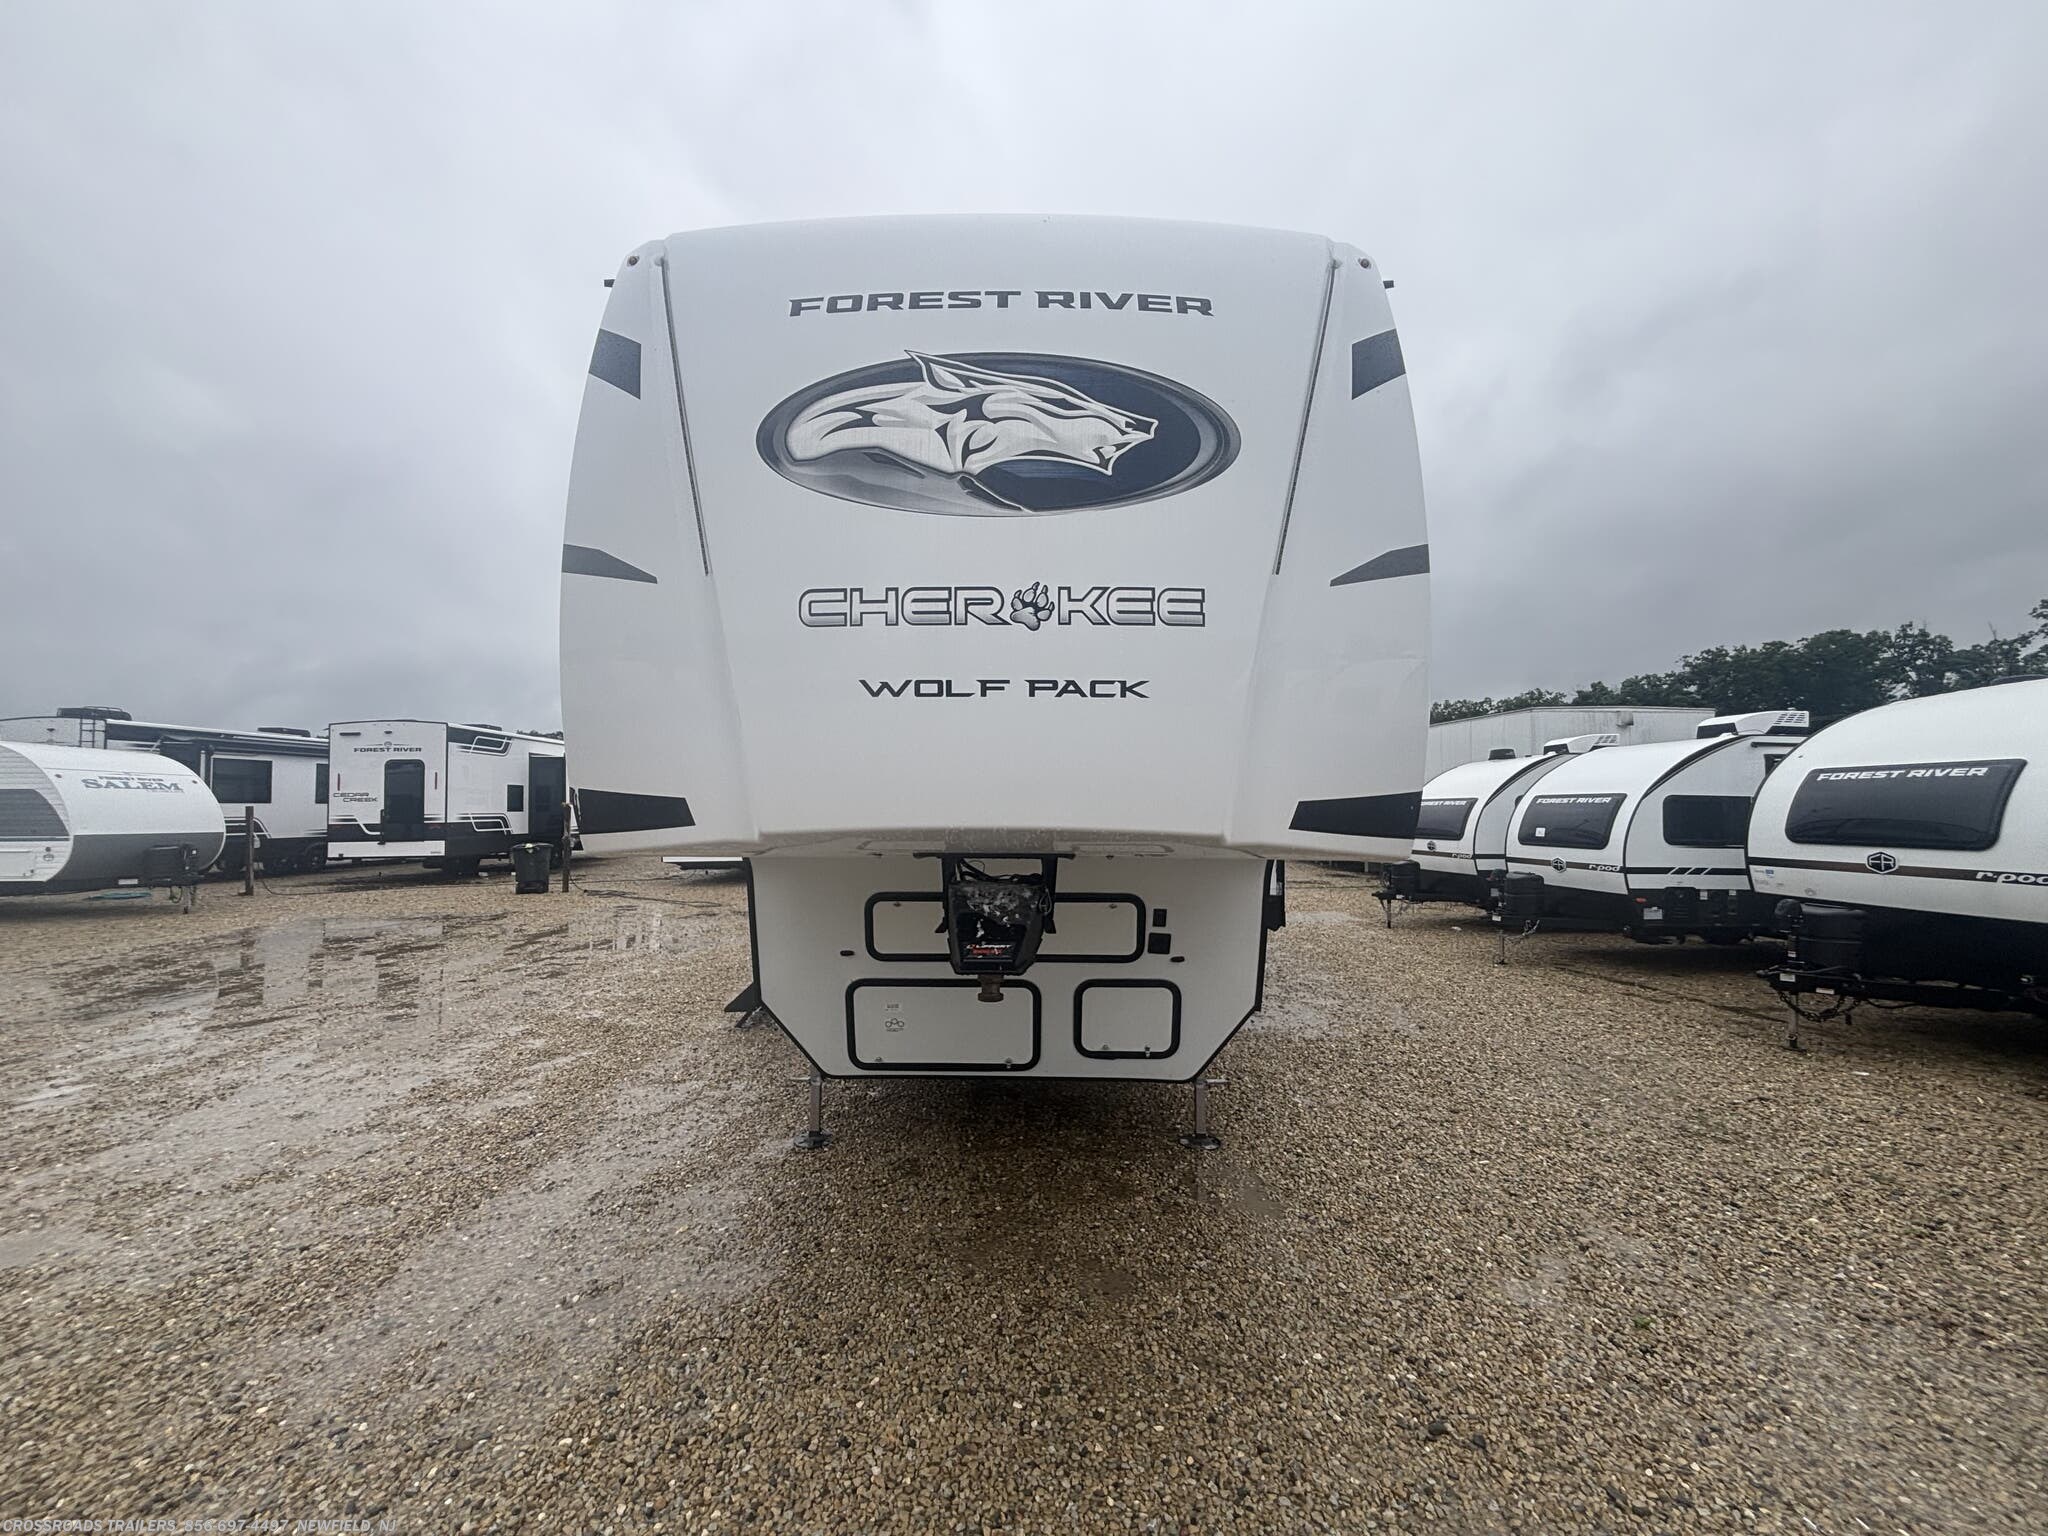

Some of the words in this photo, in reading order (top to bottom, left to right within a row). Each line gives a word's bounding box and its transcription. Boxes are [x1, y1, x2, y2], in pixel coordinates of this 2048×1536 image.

[788, 290, 1022, 317] FOREST
[1032, 290, 1215, 317] RIVER
[858, 679, 1011, 699] WOLF
[1024, 679, 1150, 699] PACK
[1816, 770, 1904, 782] FOREST
[1907, 767, 1989, 778] RIVER
[81, 778, 184, 791] SALEM
